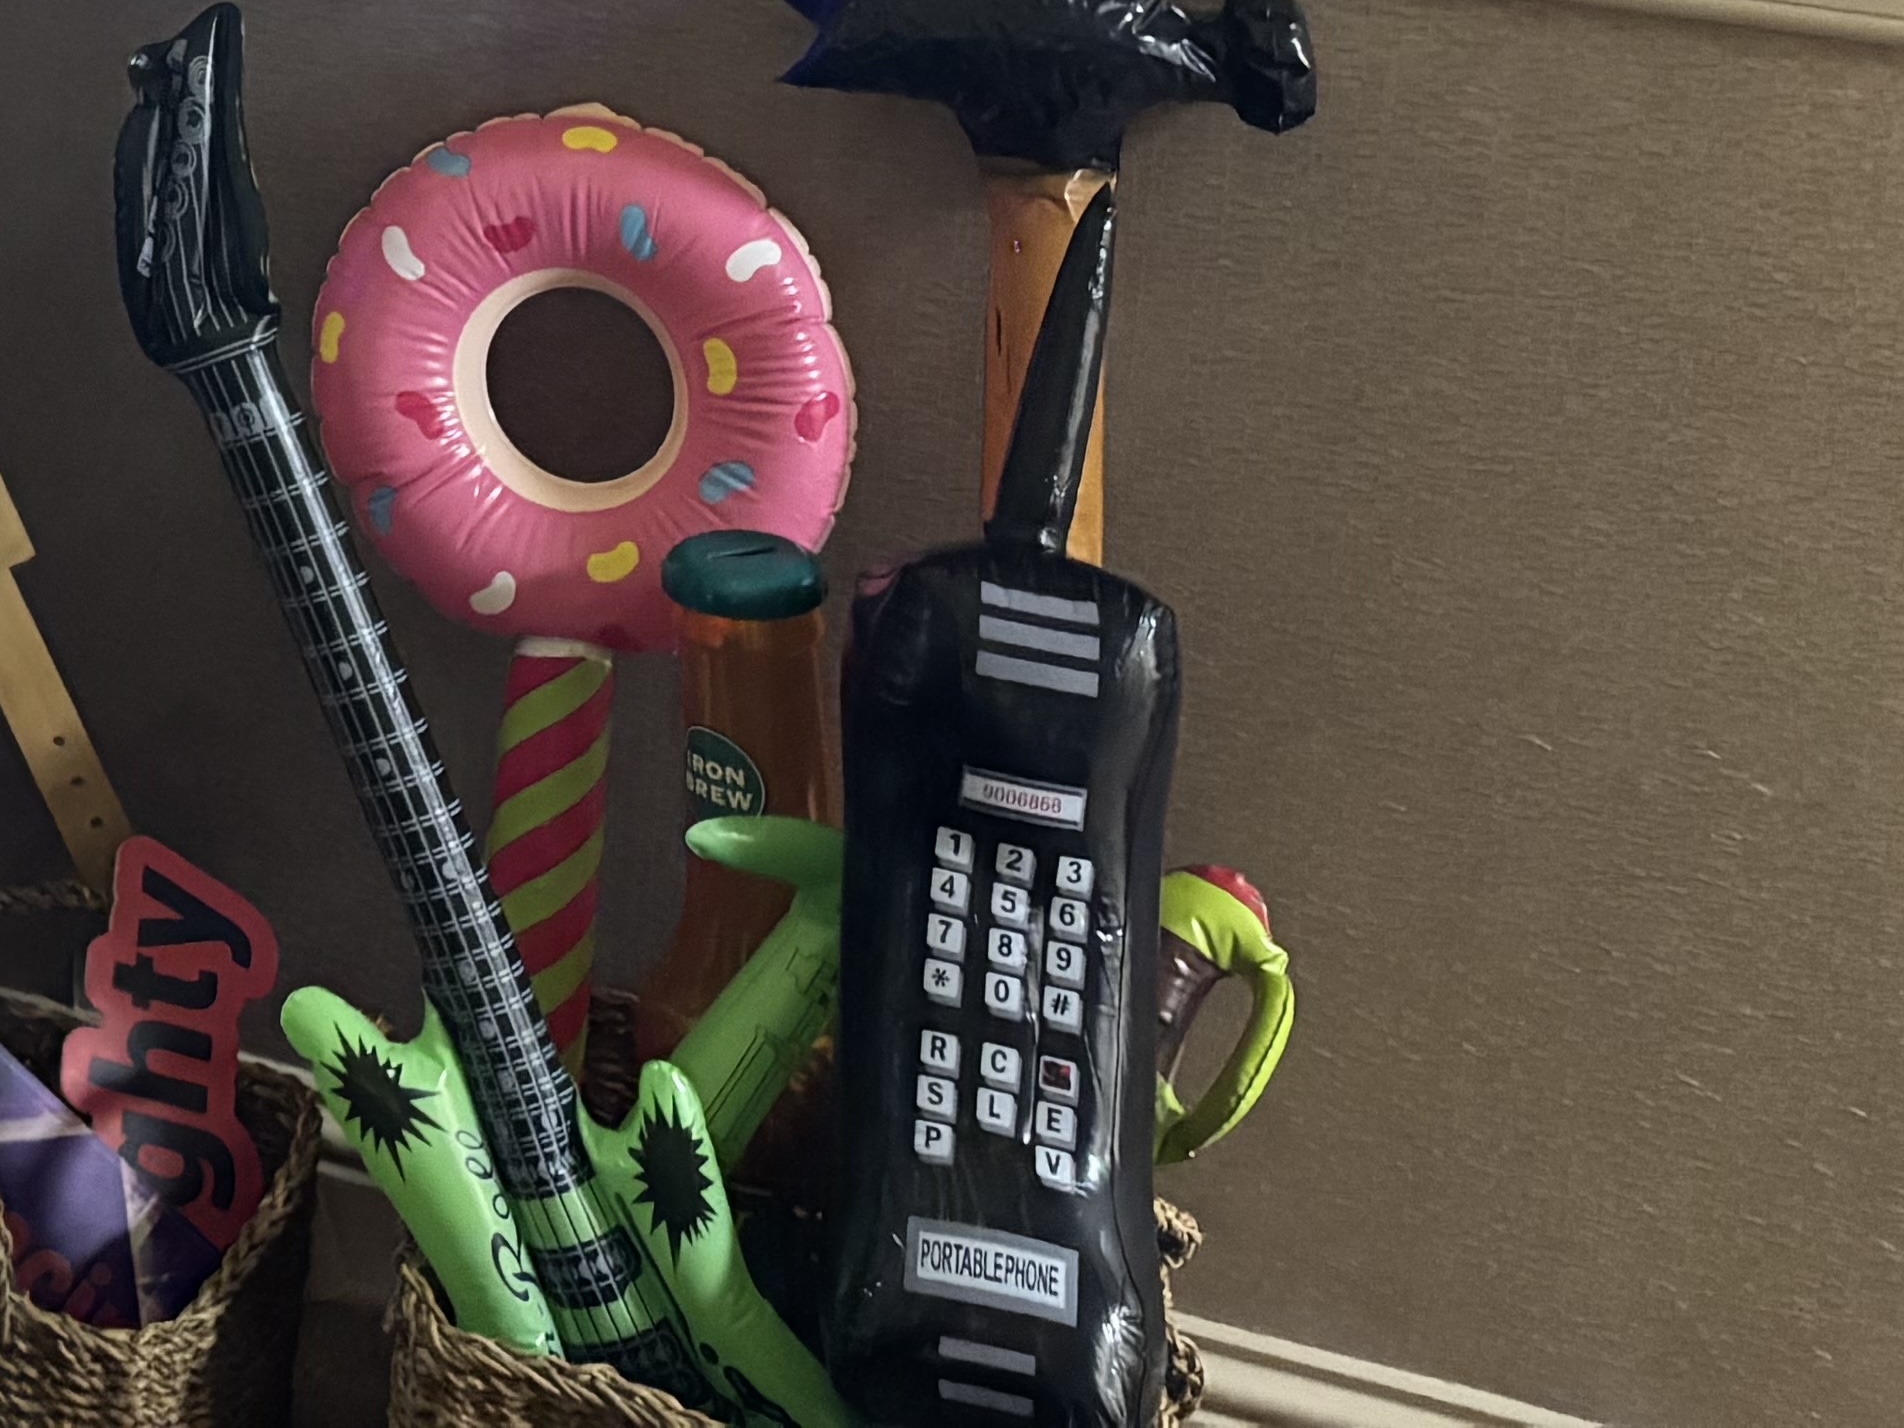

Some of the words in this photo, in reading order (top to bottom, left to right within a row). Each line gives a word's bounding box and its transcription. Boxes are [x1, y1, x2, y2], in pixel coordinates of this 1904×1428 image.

[948, 834, 960, 855] 1
[1006, 848, 1024, 872] 2
[1065, 860, 1083, 884] 3
[939, 874, 956, 899] 4
[1000, 890, 1017, 914] 5
[1059, 902, 1076, 926] 6
[937, 920, 953, 944] 7
[997, 934, 1012, 958] 8
[1055, 948, 1072, 971] 9
[994, 979, 1010, 1004] 0
[1050, 993, 1071, 1016] #
[928, 1035, 947, 1062] R
[990, 1049, 1008, 1074] C
[926, 1081, 944, 1106] S
[987, 1095, 1001, 1120] L
[1047, 1108, 1062, 1134] E
[924, 1125, 942, 1149] P
[1044, 1150, 1062, 1176] V
[920, 1239, 1059, 1297] PORTABLEPHONE
